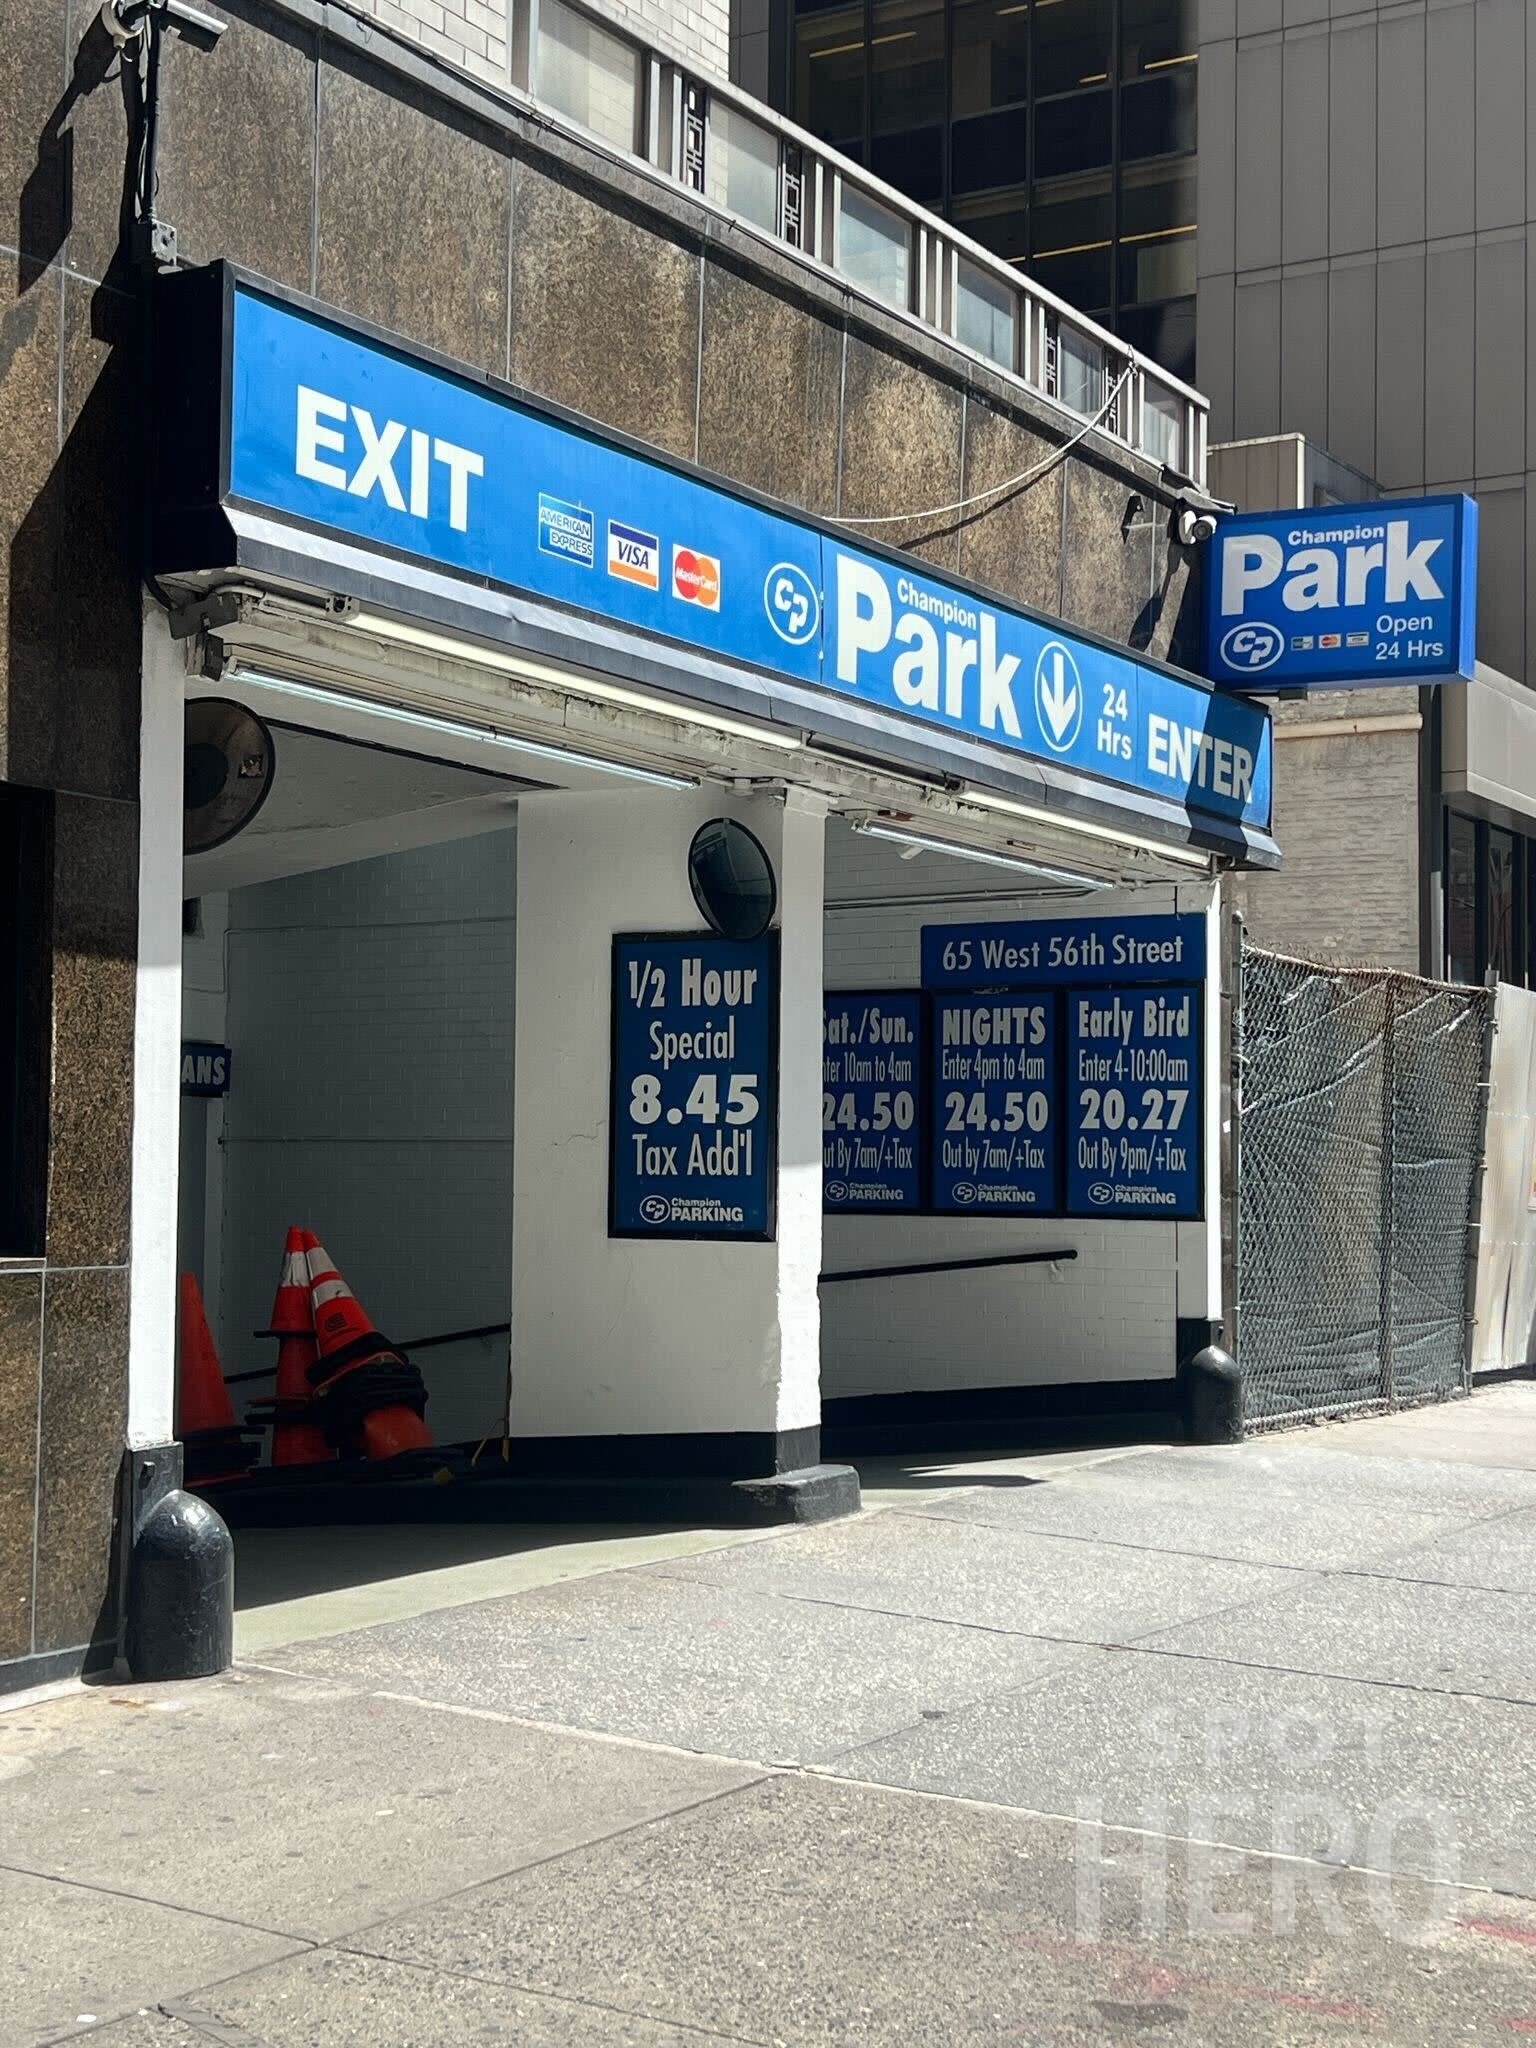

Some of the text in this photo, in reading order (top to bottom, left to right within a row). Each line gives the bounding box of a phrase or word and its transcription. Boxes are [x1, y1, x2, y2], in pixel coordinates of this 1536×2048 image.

[296, 386, 484, 533] EXIT
[540, 509, 590, 537] AMERICAN
[1288, 525, 1385, 546] Champion
[551, 532, 593, 556] EXPRESS
[617, 540, 650, 570] VISA
[675, 567, 718, 590] MasterCard
[1221, 520, 1445, 617] Park
[897, 578, 977, 629] Champion
[1376, 614, 1433, 636] Open
[836, 553, 1023, 739] Park
[1375, 639, 1444, 661] 24 Hrs
[1103, 683, 1128, 719] 24
[1097, 718, 1133, 760] Hrs
[1147, 712, 1254, 805] ENTER
[942, 932, 1184, 971] 65 West 56th Street
[629, 958, 758, 1009] 1/2 Hour
[942, 1006, 1046, 1046] NIGHTS
[1079, 996, 1190, 1046] Early Bird
[649, 1015, 735, 1070] Special
[181, 1055, 226, 1086] ANS
[823, 1051, 912, 1082] nter 10am to 4am
[942, 1048, 1045, 1088] Enter 4pm to 4am
[1079, 1048, 1189, 1082] Enter 4-10:00am
[629, 1073, 760, 1125] 8.45
[823, 1090, 915, 1131] 24.50
[945, 1091, 1049, 1132] 24.50
[1080, 1088, 1190, 1131] 20.27
[632, 1129, 752, 1176] Tax Add'l
[823, 1141, 835, 1169] ut
[838, 1137, 852, 1177] By
[942, 1139, 963, 1168] Out
[965, 1136, 980, 1176] by
[1078, 1136, 1099, 1169] Out
[1101, 1136, 1118, 1178] By
[671, 1197, 722, 1208] Champion
[849, 1182, 888, 1190] Champion
[849, 1189, 904, 1201] PARKING
[978, 1183, 1018, 1192] Champion
[978, 1191, 1037, 1203] PARKING
[1115, 1184, 1158, 1193] Champion
[1115, 1192, 1177, 1205] PARKING
[671, 1207, 744, 1222] PARKING
